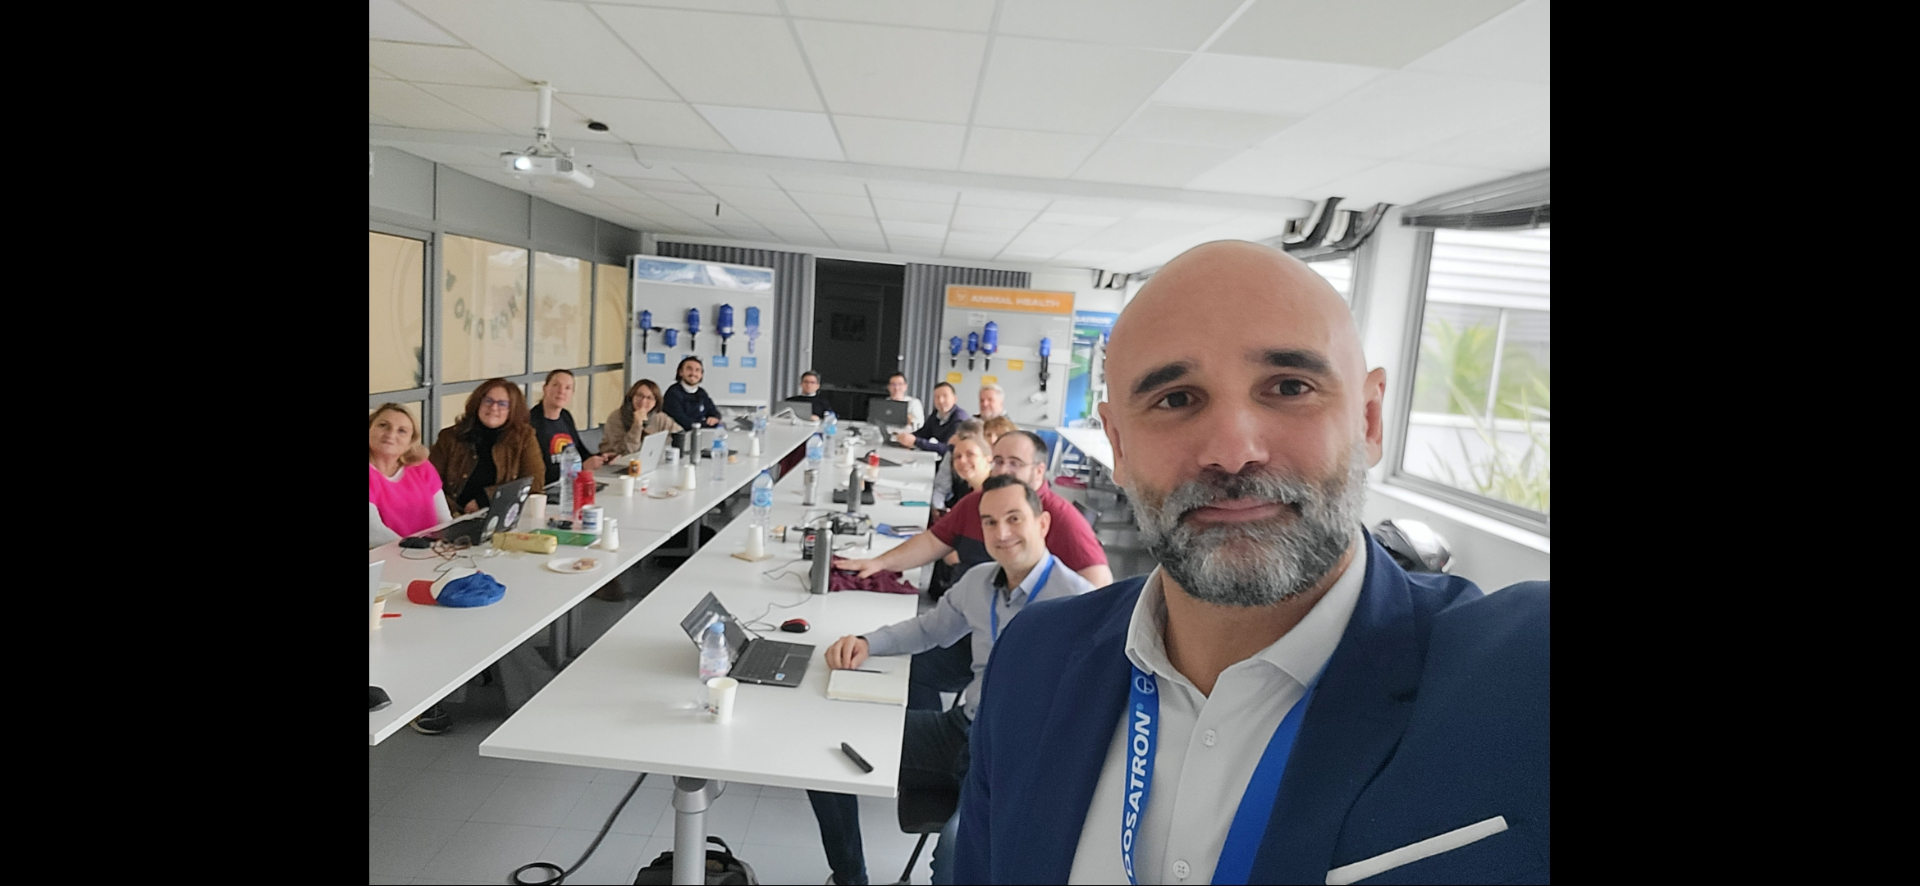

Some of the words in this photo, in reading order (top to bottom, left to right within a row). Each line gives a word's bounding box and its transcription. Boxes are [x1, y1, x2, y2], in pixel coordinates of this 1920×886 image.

[971, 295, 1013, 305] ANIMAL
[1016, 298, 1060, 308] HEALTH
[1074, 316, 1112, 325] SATRON
[1123, 711, 1151, 877] DOSATRON
